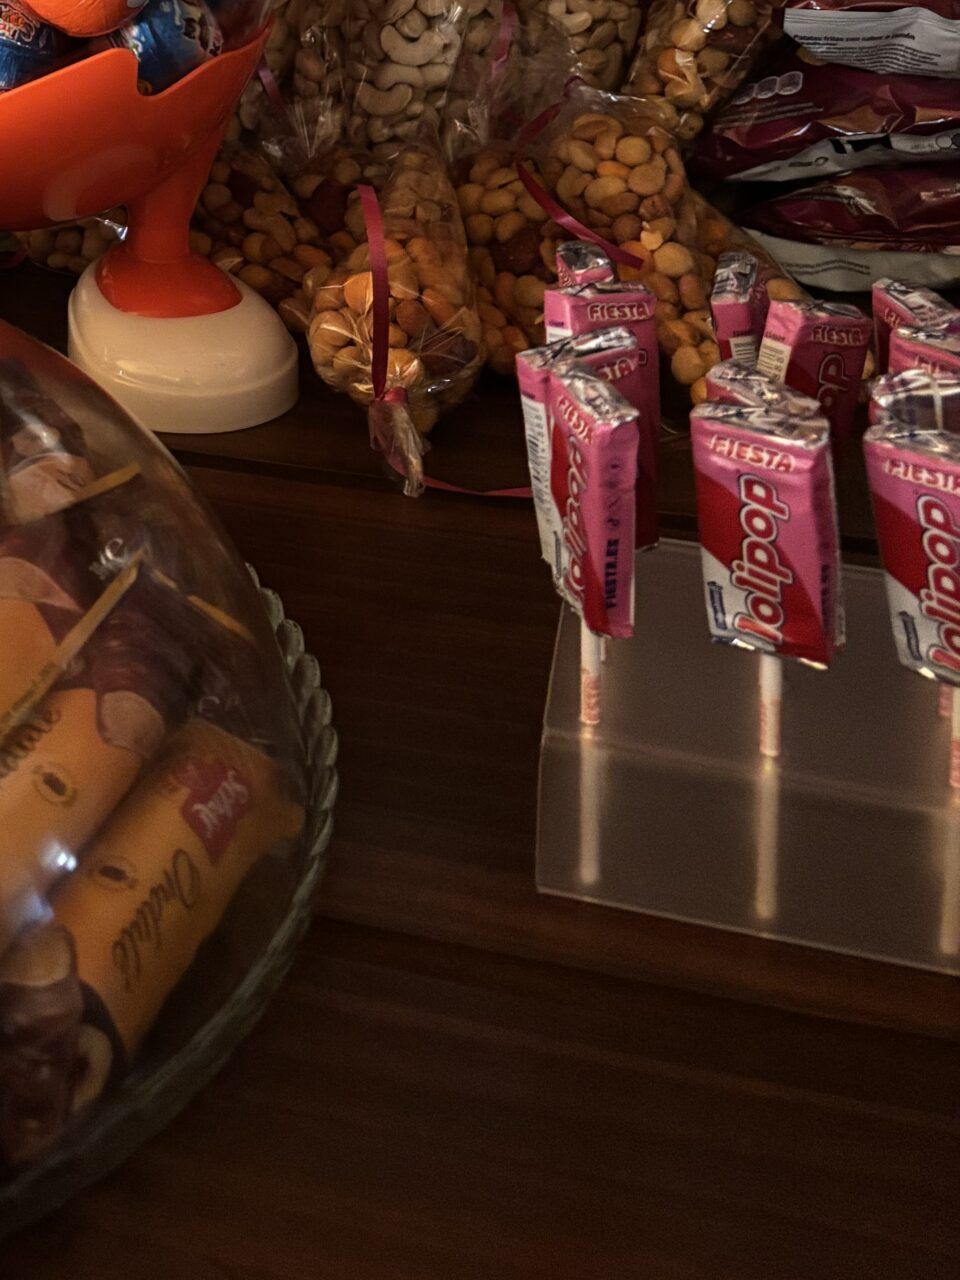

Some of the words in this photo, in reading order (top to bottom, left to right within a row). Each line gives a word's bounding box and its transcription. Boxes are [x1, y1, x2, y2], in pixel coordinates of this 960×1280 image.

[588, 302, 650, 321] FIESTA
[709, 434, 796, 473] FIESTA
[732, 474, 792, 644] lolipop
